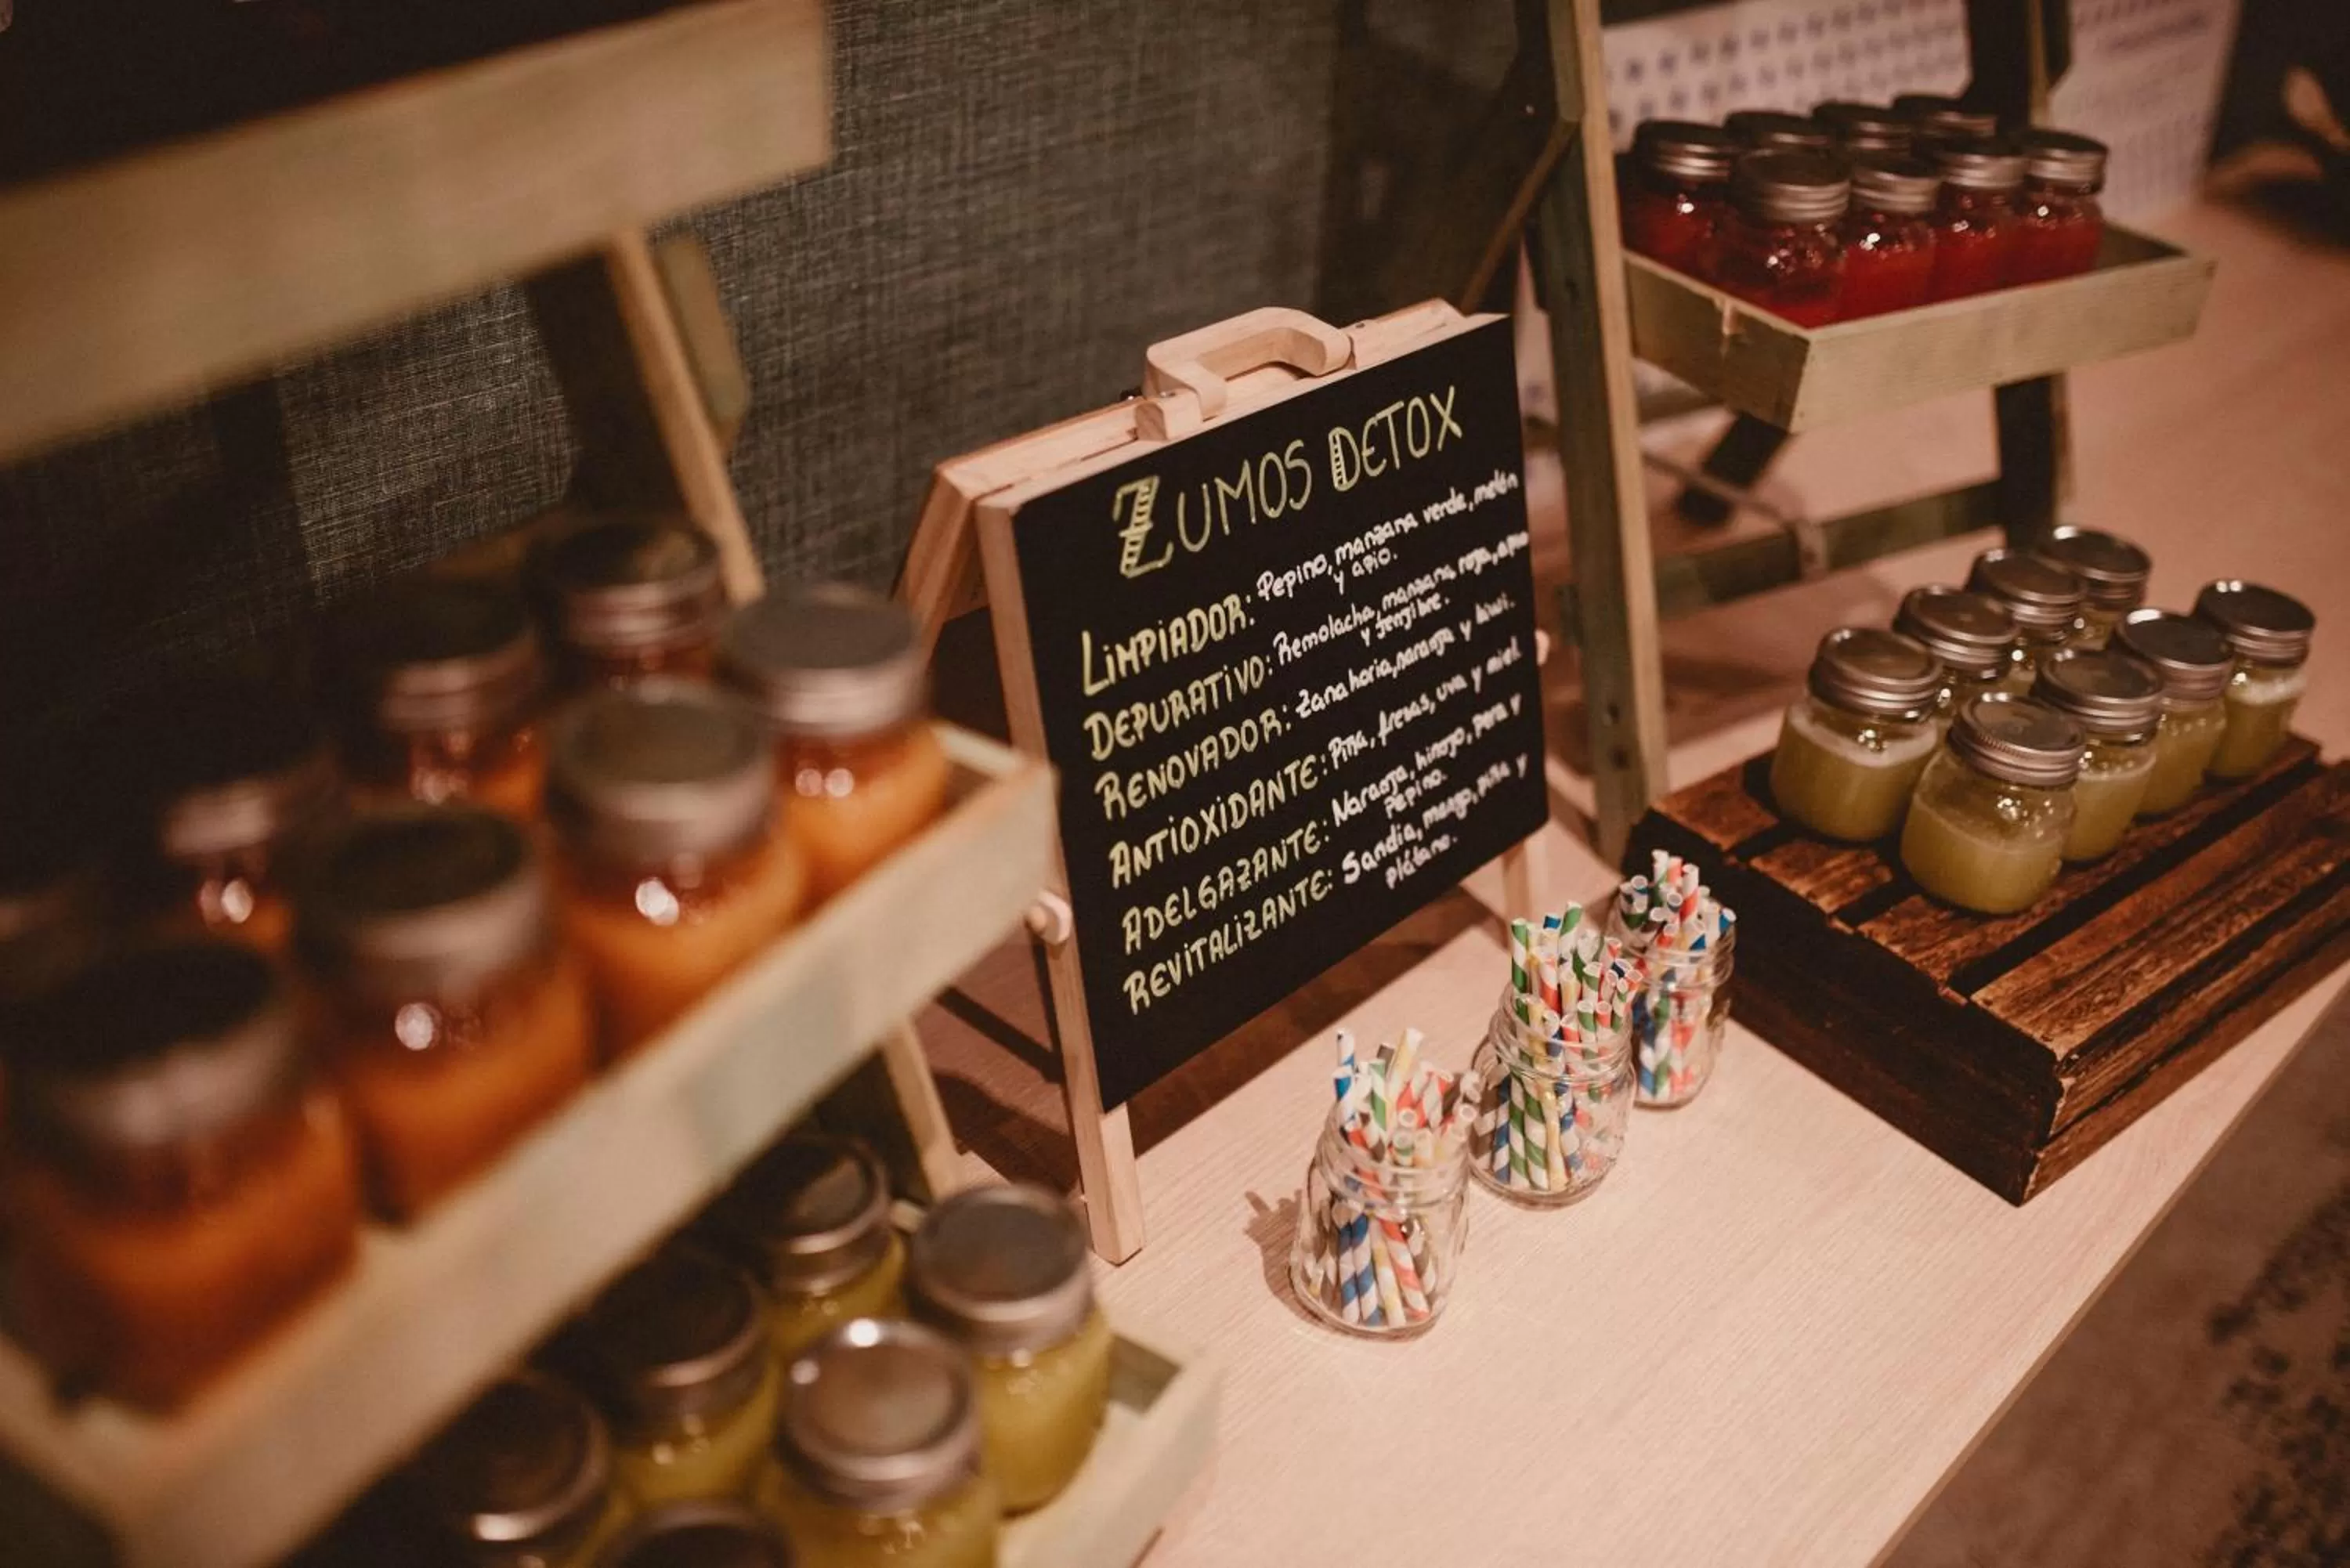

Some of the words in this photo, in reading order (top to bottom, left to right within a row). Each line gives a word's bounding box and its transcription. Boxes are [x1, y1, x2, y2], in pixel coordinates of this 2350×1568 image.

[1112, 439, 1312, 578] ZUMOS
[1328, 385, 1462, 492] DETOX
[1256, 554, 1332, 601] Pepino,
[1335, 513, 1419, 565] manzana
[1333, 570, 1344, 596] y
[1381, 563, 1456, 613] manzana
[1361, 627, 1372, 647] y
[1471, 666, 1482, 693] y
[1094, 705, 1291, 820] RENOVADOR:
[1459, 620, 1471, 641] y
[1517, 753, 1528, 779] y
[1121, 819, 1329, 956] ADELGAZANTE:
[1510, 692, 1521, 716] y
